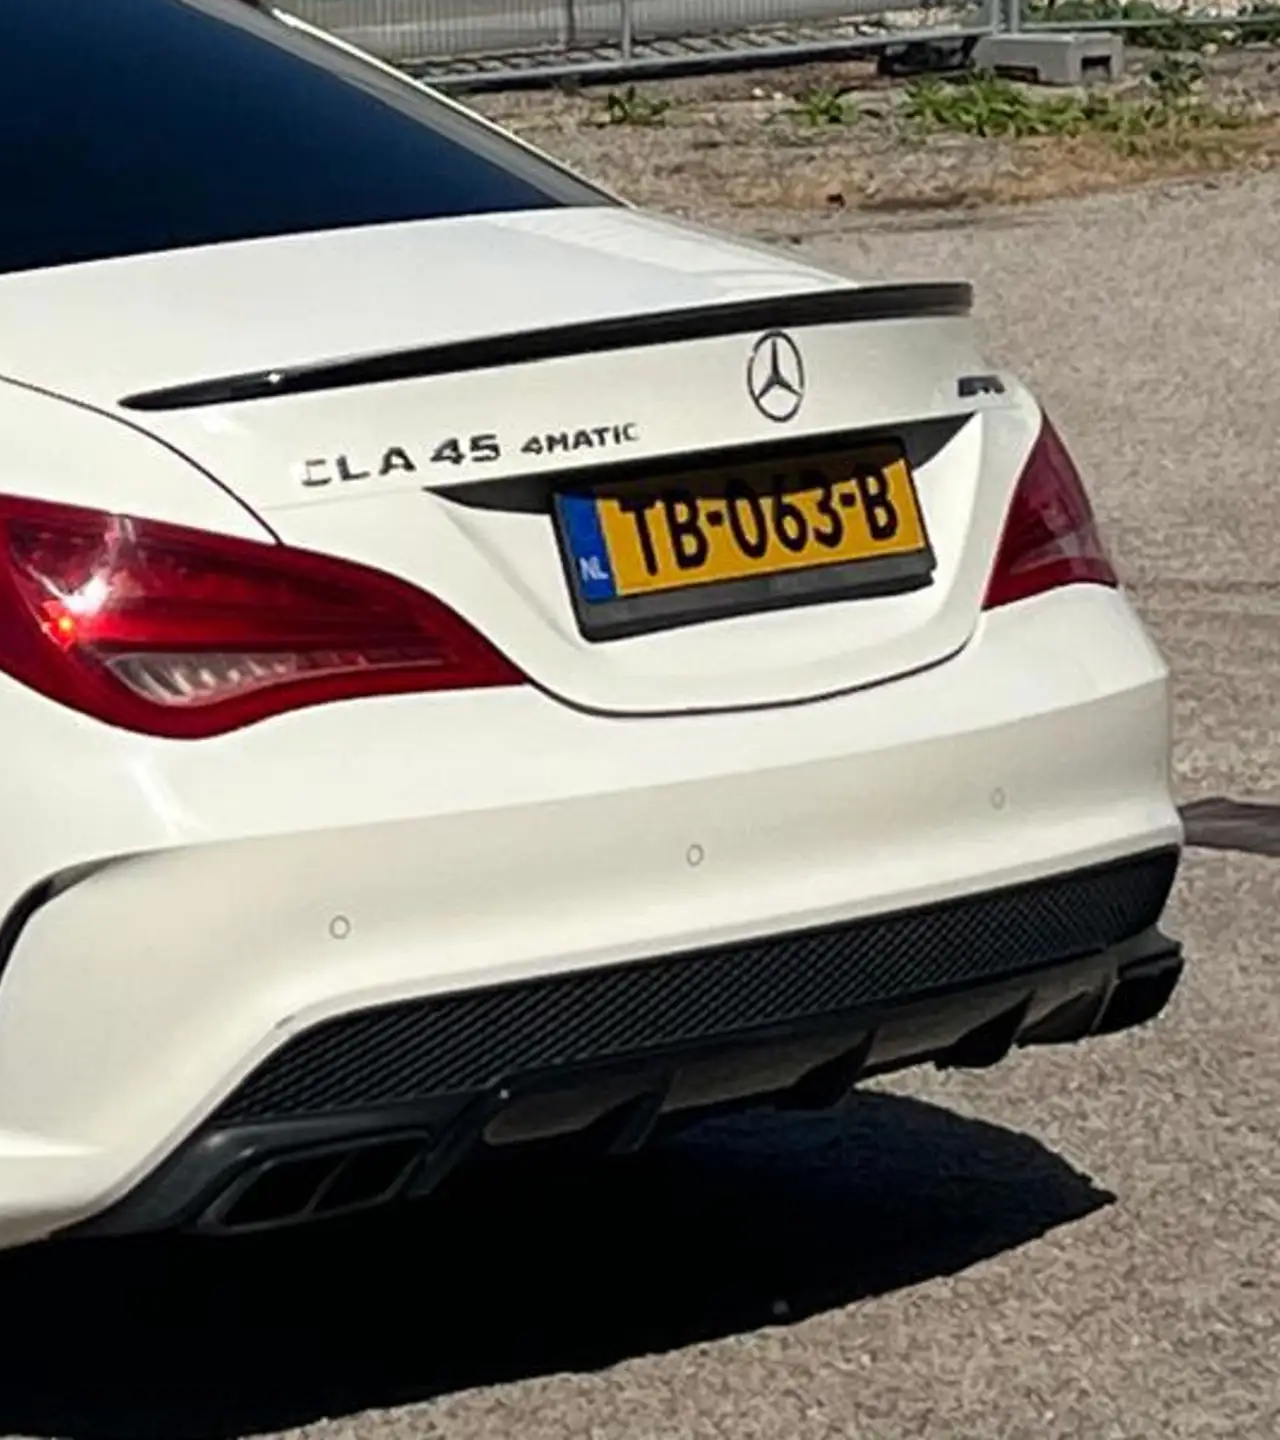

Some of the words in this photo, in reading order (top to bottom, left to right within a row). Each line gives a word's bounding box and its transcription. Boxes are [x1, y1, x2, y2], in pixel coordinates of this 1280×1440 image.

[301, 446, 417, 487] CLA
[430, 434, 501, 464] 45
[520, 423, 640, 455] 4MATIC
[618, 464, 897, 576] TB-063-B
[579, 556, 609, 581] NL
